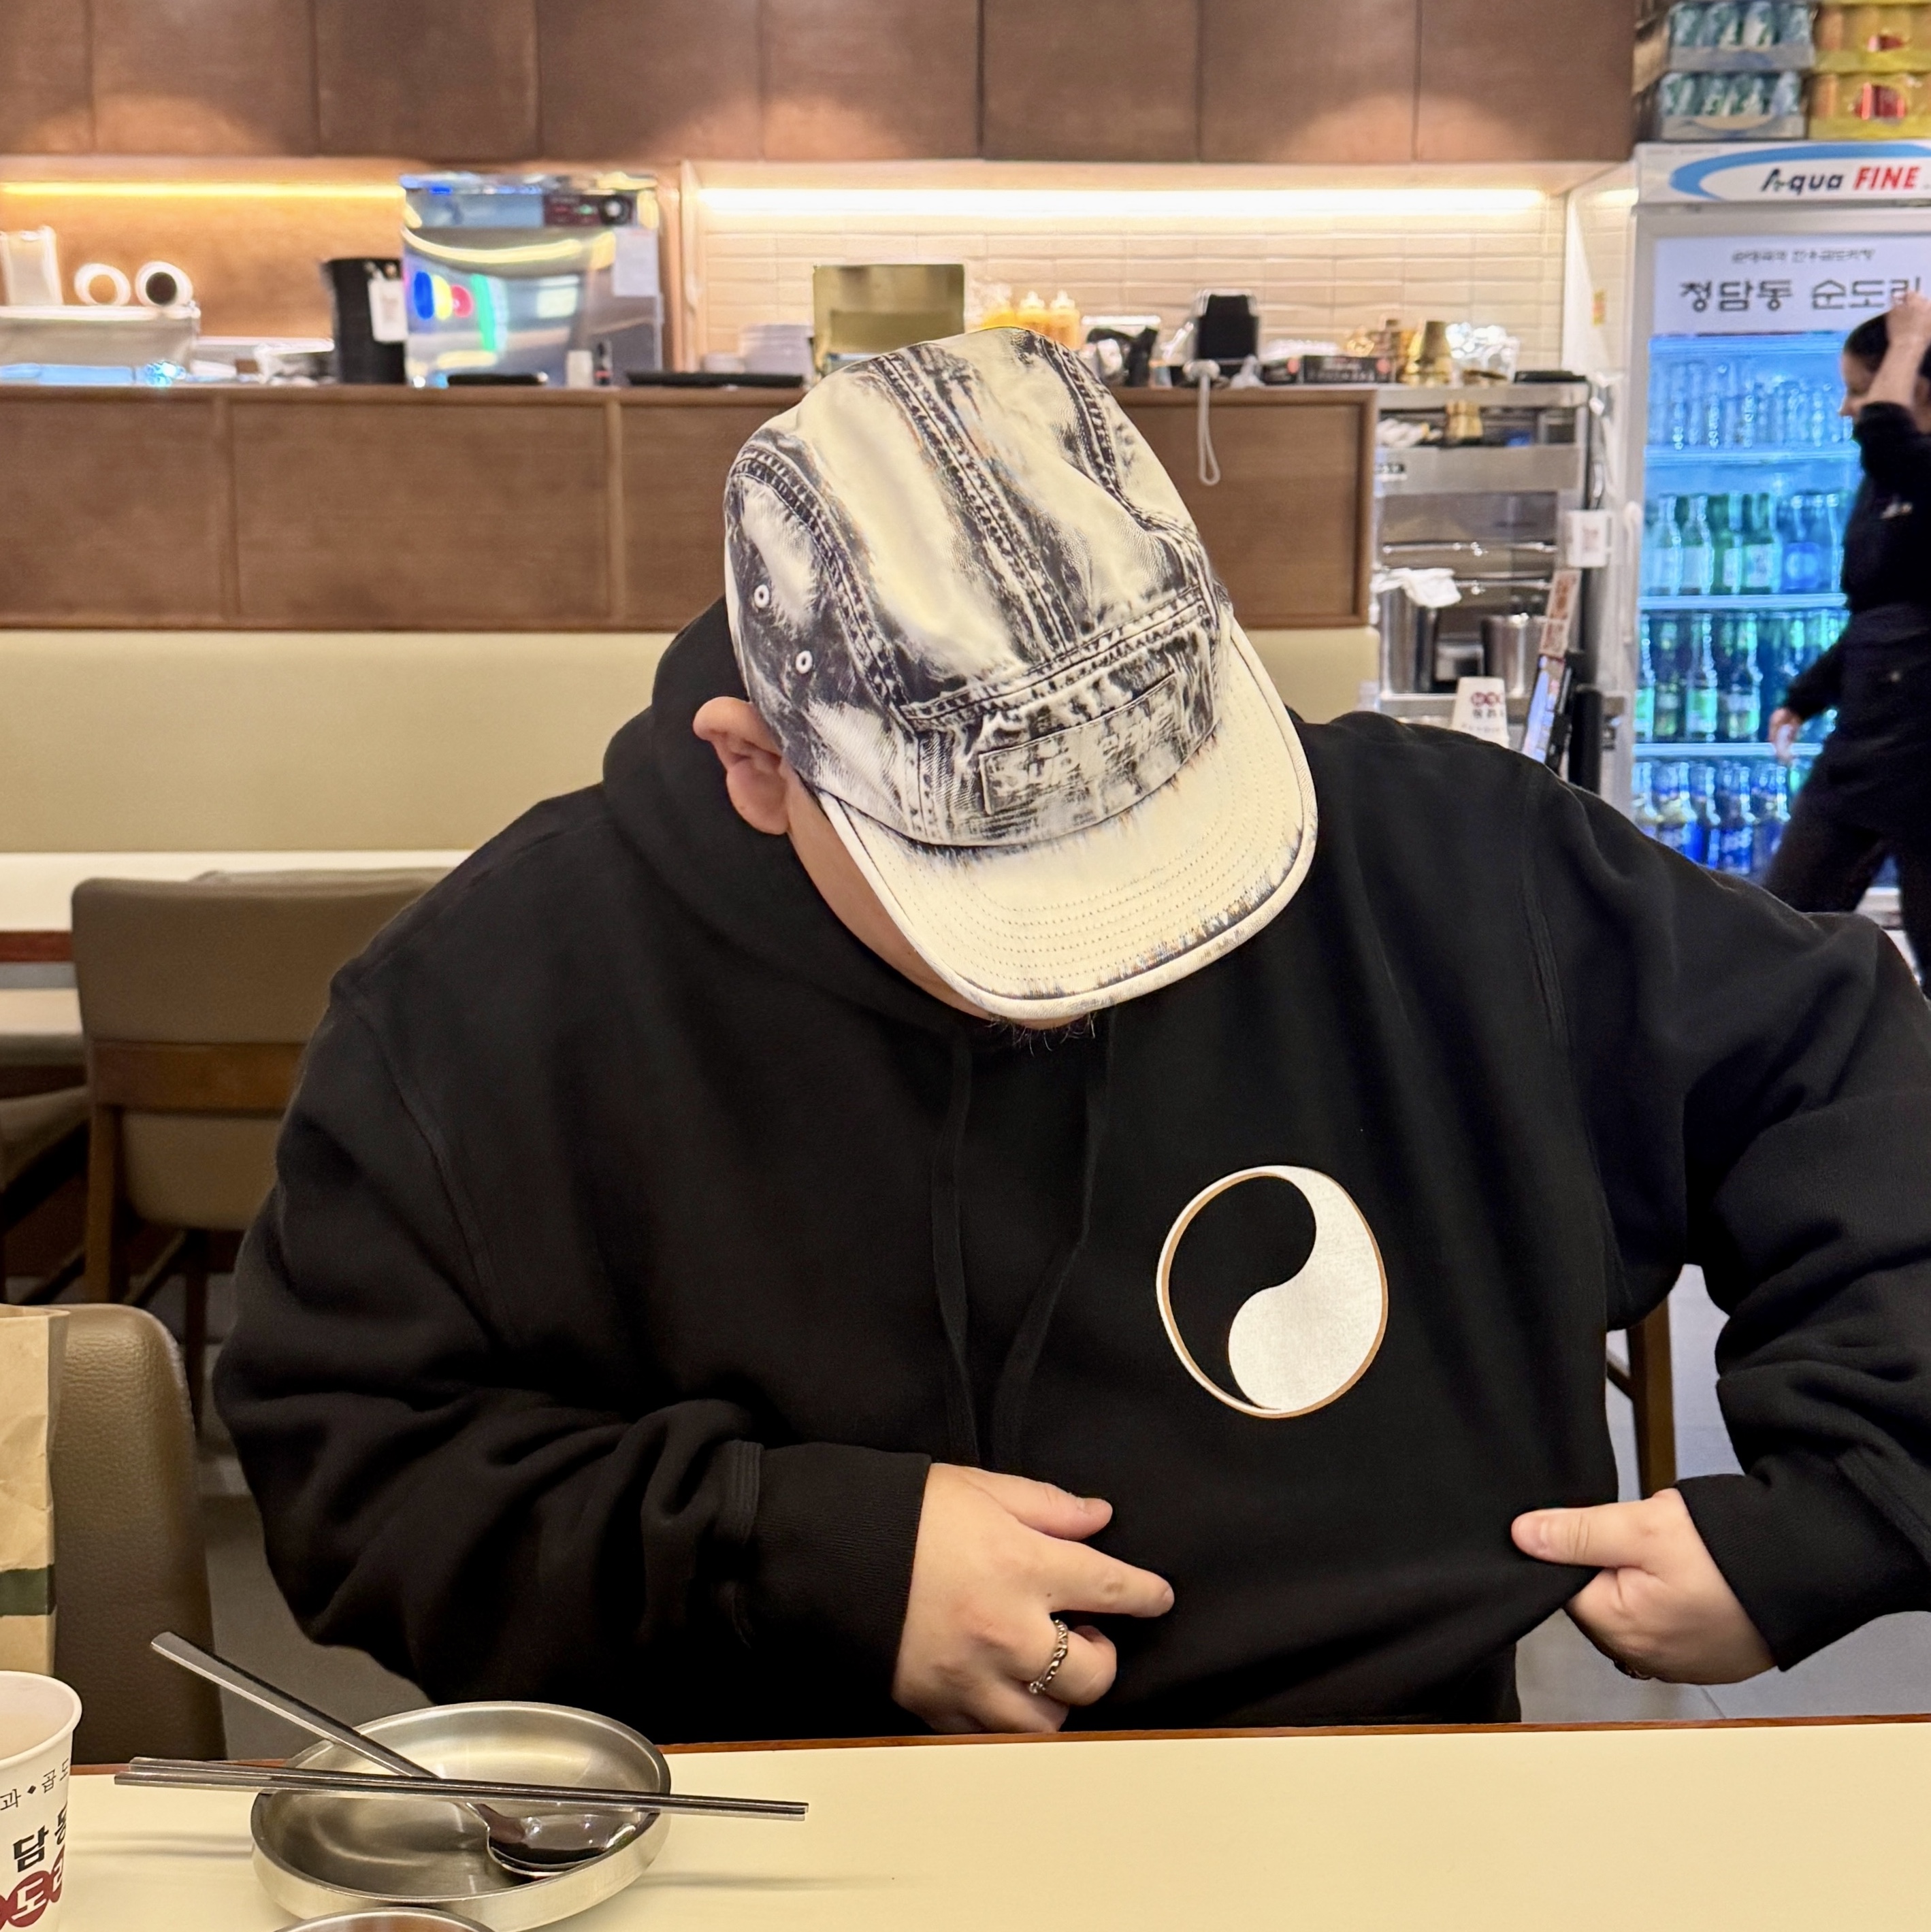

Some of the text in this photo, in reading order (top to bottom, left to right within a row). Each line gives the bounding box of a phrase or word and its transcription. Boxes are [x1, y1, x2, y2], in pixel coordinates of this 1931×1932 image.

[1761, 165, 1921, 195] Aqua FINE
[1680, 279, 1792, 312] 청담동
